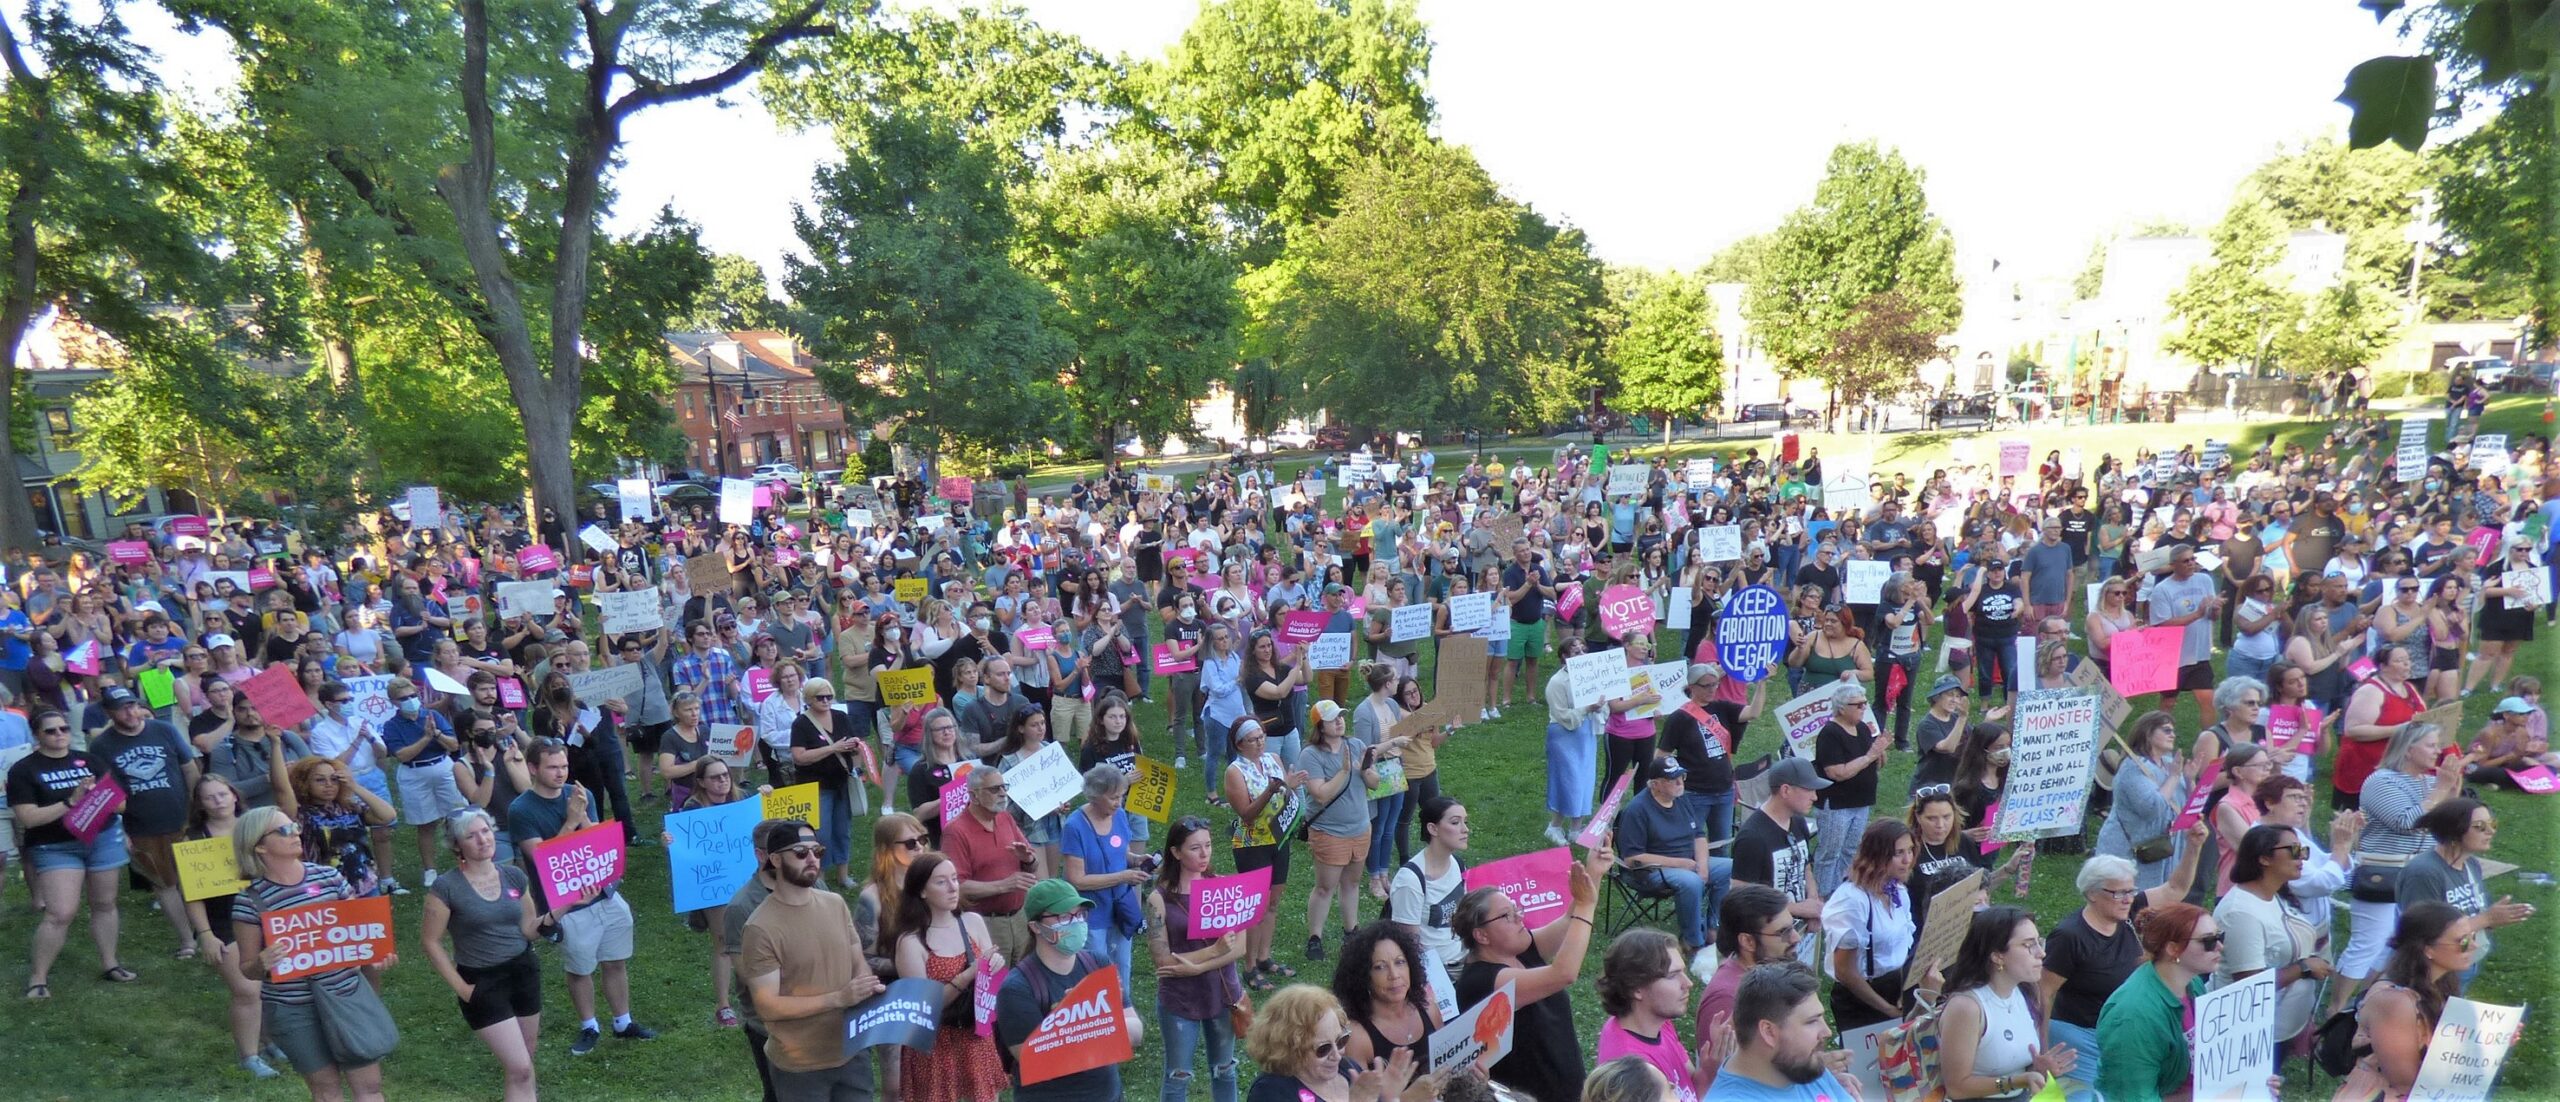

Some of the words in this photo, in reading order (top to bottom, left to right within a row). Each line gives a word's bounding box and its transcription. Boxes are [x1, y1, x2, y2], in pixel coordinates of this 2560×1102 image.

[1602, 595, 1651, 621] VOTE
[1732, 588, 1778, 616] KEEP
[1288, 626, 1309, 634] Health
[1719, 615, 1786, 644] ABORTION
[1569, 660, 1593, 673] Having
[1724, 643, 1778, 671] LEGAL
[1613, 666, 1625, 676] be
[1659, 667, 1685, 690] REALLY
[370, 679, 390, 691] YOU
[883, 676, 909, 687] BANS
[903, 682, 928, 692] OUR
[888, 690, 925, 701] BODIES
[2025, 701, 2053, 713] WHAT
[2058, 699, 2078, 710] KIND
[2081, 698, 2093, 707] OF
[1785, 697, 1832, 728] RESPEC
[2026, 709, 2093, 732] MONSTER
[711, 737, 733, 746] RIGHT
[2022, 735, 2053, 746] WANTS
[2055, 729, 2080, 742] MORE
[115, 746, 168, 766] SHIBE
[2021, 751, 2042, 763] KIDS
[2046, 746, 2056, 757] IN
[2059, 740, 2092, 757] FOSTER
[41, 767, 94, 784] RADICAL
[1020, 765, 1039, 782] YOUR
[1038, 749, 1064, 771] body
[2015, 767, 2044, 779] CARE
[2045, 762, 2064, 775] AND
[2067, 759, 2085, 770] ALL
[50, 778, 83, 791] FEMIN
[129, 778, 171, 794] PARK
[946, 782, 969, 801] BANS
[1049, 770, 1077, 793] choice
[1143, 786, 1156, 810] OFF
[1150, 764, 1161, 787] OUR
[1152, 769, 1170, 813] BODIES
[2011, 784, 2036, 796] KIDS
[2040, 776, 2076, 790] BEHIND
[766, 794, 794, 810] BANS
[1134, 776, 1150, 808] BANS
[787, 803, 812, 814] OUR
[946, 795, 962, 811] OFF
[946, 806, 968, 822] BOD
[2019, 805, 2065, 828] GLASS?
[189, 860, 216, 873] YOU
[548, 844, 594, 870] BANS
[551, 862, 585, 883] OFF
[585, 848, 619, 871] OUR
[554, 863, 614, 897] BODIES
[691, 861, 729, 885] YOUR
[195, 878, 206, 889] if
[701, 884, 737, 901] Cho
[1525, 878, 1537, 891] is
[1202, 884, 1244, 904] BANS
[1519, 890, 1562, 906] Care.
[1199, 901, 1233, 917] OFF
[1232, 893, 1263, 913] OUR
[270, 908, 338, 935] BANS
[1200, 907, 1256, 930] BODIES
[276, 930, 323, 955] OFF
[327, 923, 387, 945] OUR
[276, 943, 375, 976] BODIES
[857, 997, 921, 1025] Abortion
[922, 1000, 933, 1015] is
[981, 992, 998, 1010] OUR
[1039, 988, 1113, 1033] ywca
[857, 1010, 906, 1034] Health
[907, 1011, 936, 1031] Care.
[1059, 1015, 1114, 1037] empowering
[2479, 1009, 2507, 1024] MY
[1027, 1032, 1057, 1047] women
[1064, 1025, 1117, 1045] eliminating
[2440, 1022, 2512, 1046] CHILDRE
[1033, 1037, 1064, 1054] racism
[1434, 1035, 1470, 1068] RIGHT
[1450, 1042, 1489, 1076] CISION
[2440, 1051, 2490, 1069] SHOULD
[2450, 1072, 2484, 1087] HAVE
